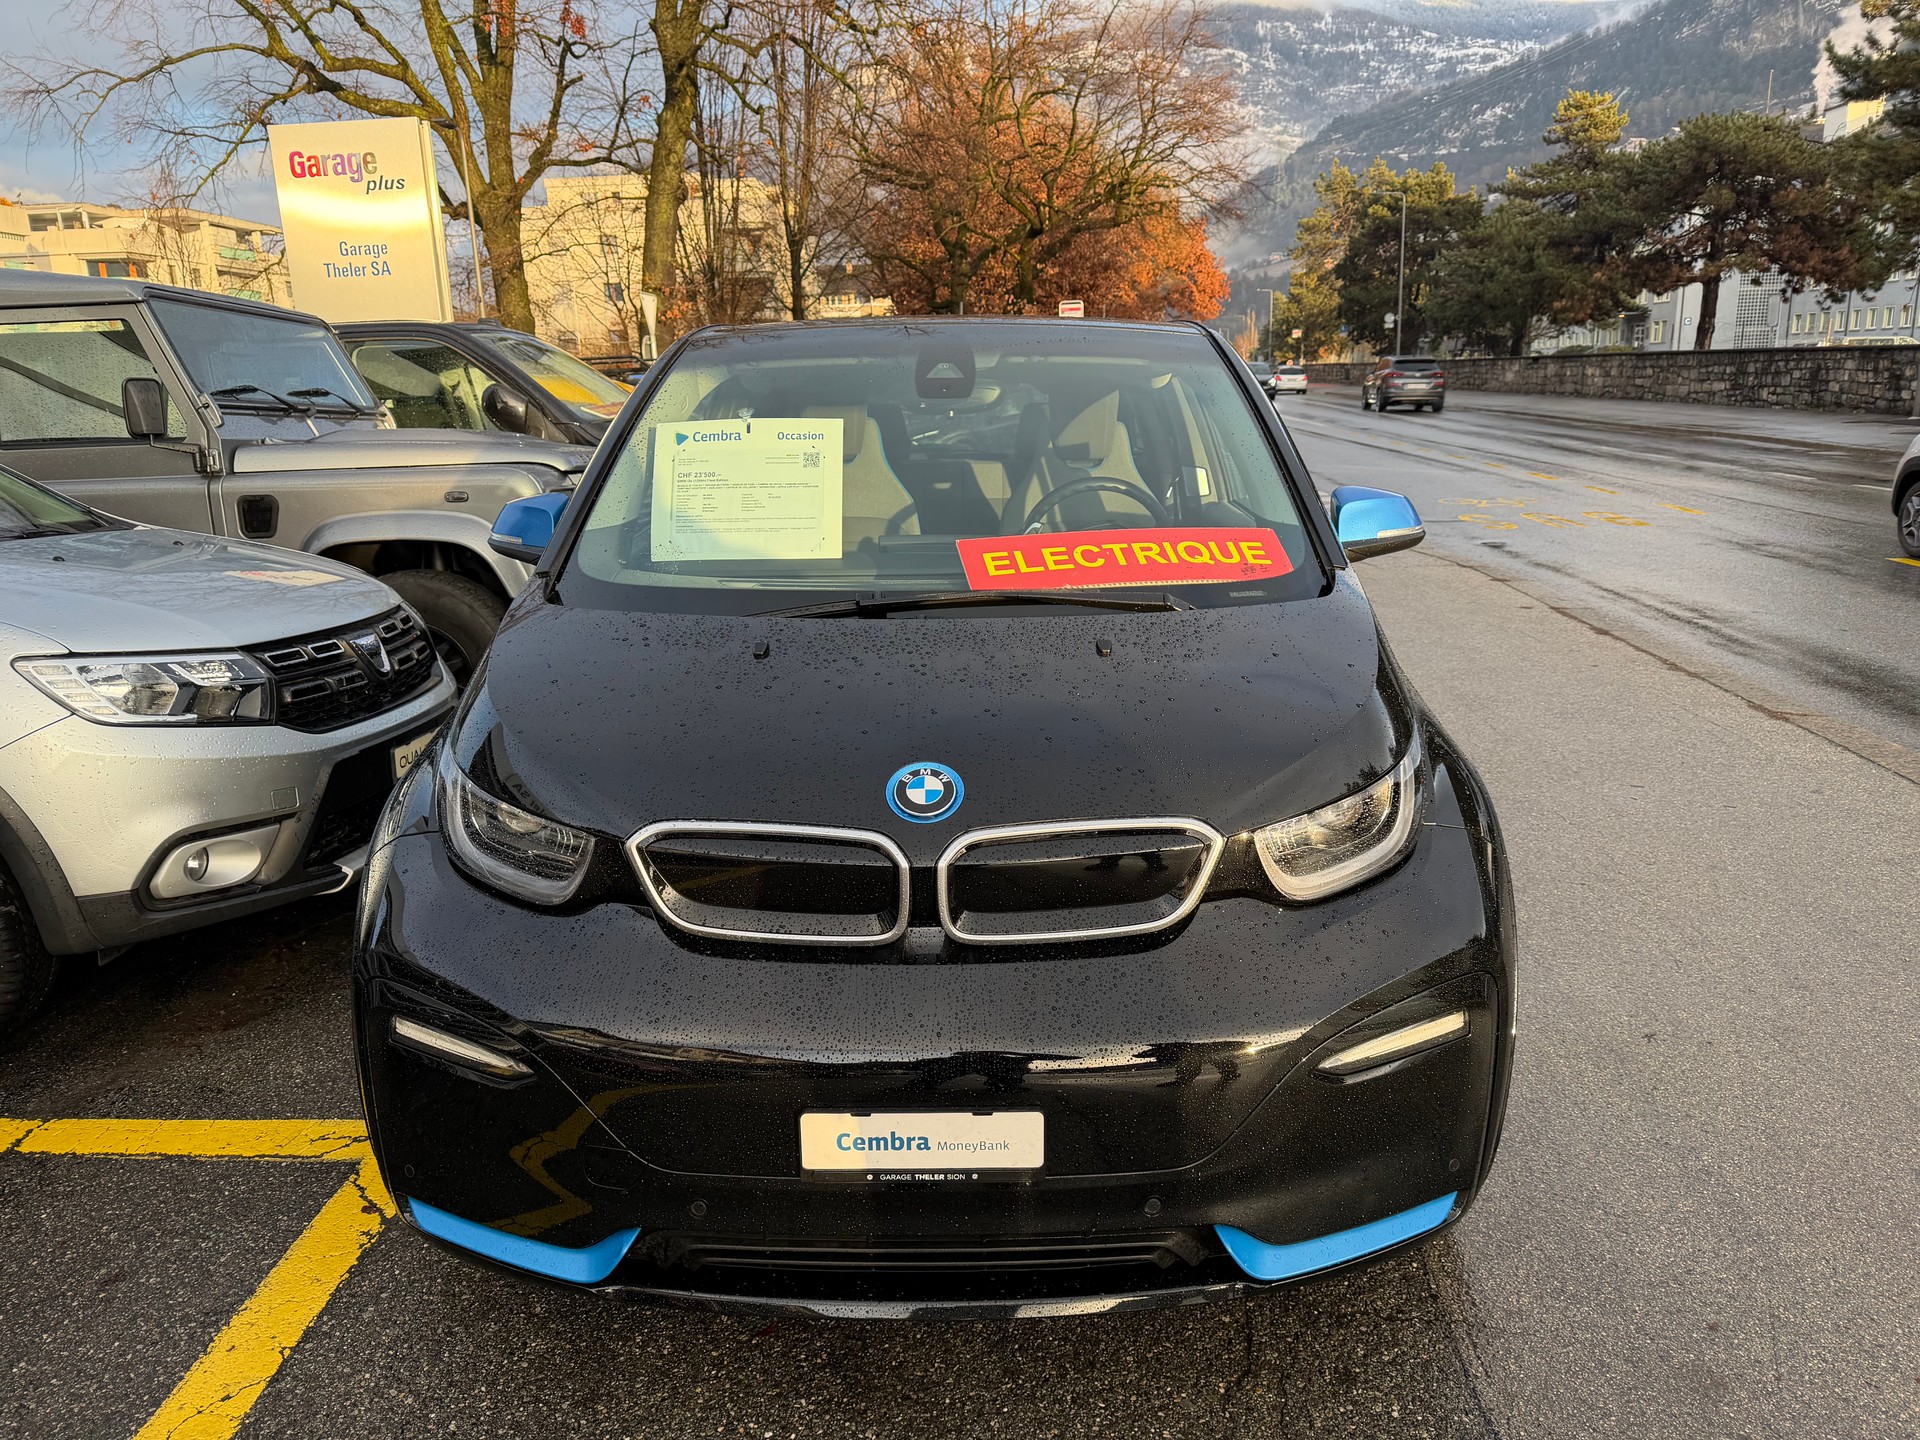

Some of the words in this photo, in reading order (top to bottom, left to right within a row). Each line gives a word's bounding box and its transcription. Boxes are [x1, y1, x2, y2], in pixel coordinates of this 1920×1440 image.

[289, 151, 378, 183] Garage
[366, 175, 406, 194] plus
[339, 241, 388, 259] Garage
[323, 262, 367, 278] Theler
[370, 261, 392, 276] SA
[692, 430, 742, 443] Cembra
[777, 431, 824, 441] Occasion
[982, 541, 1272, 577] ELECTRIQUE
[901, 768, 951, 783] BMW
[836, 1131, 931, 1152] Cembra
[937, 1140, 1010, 1154] MoneyBank
[946, 1173, 966, 1181] SION
